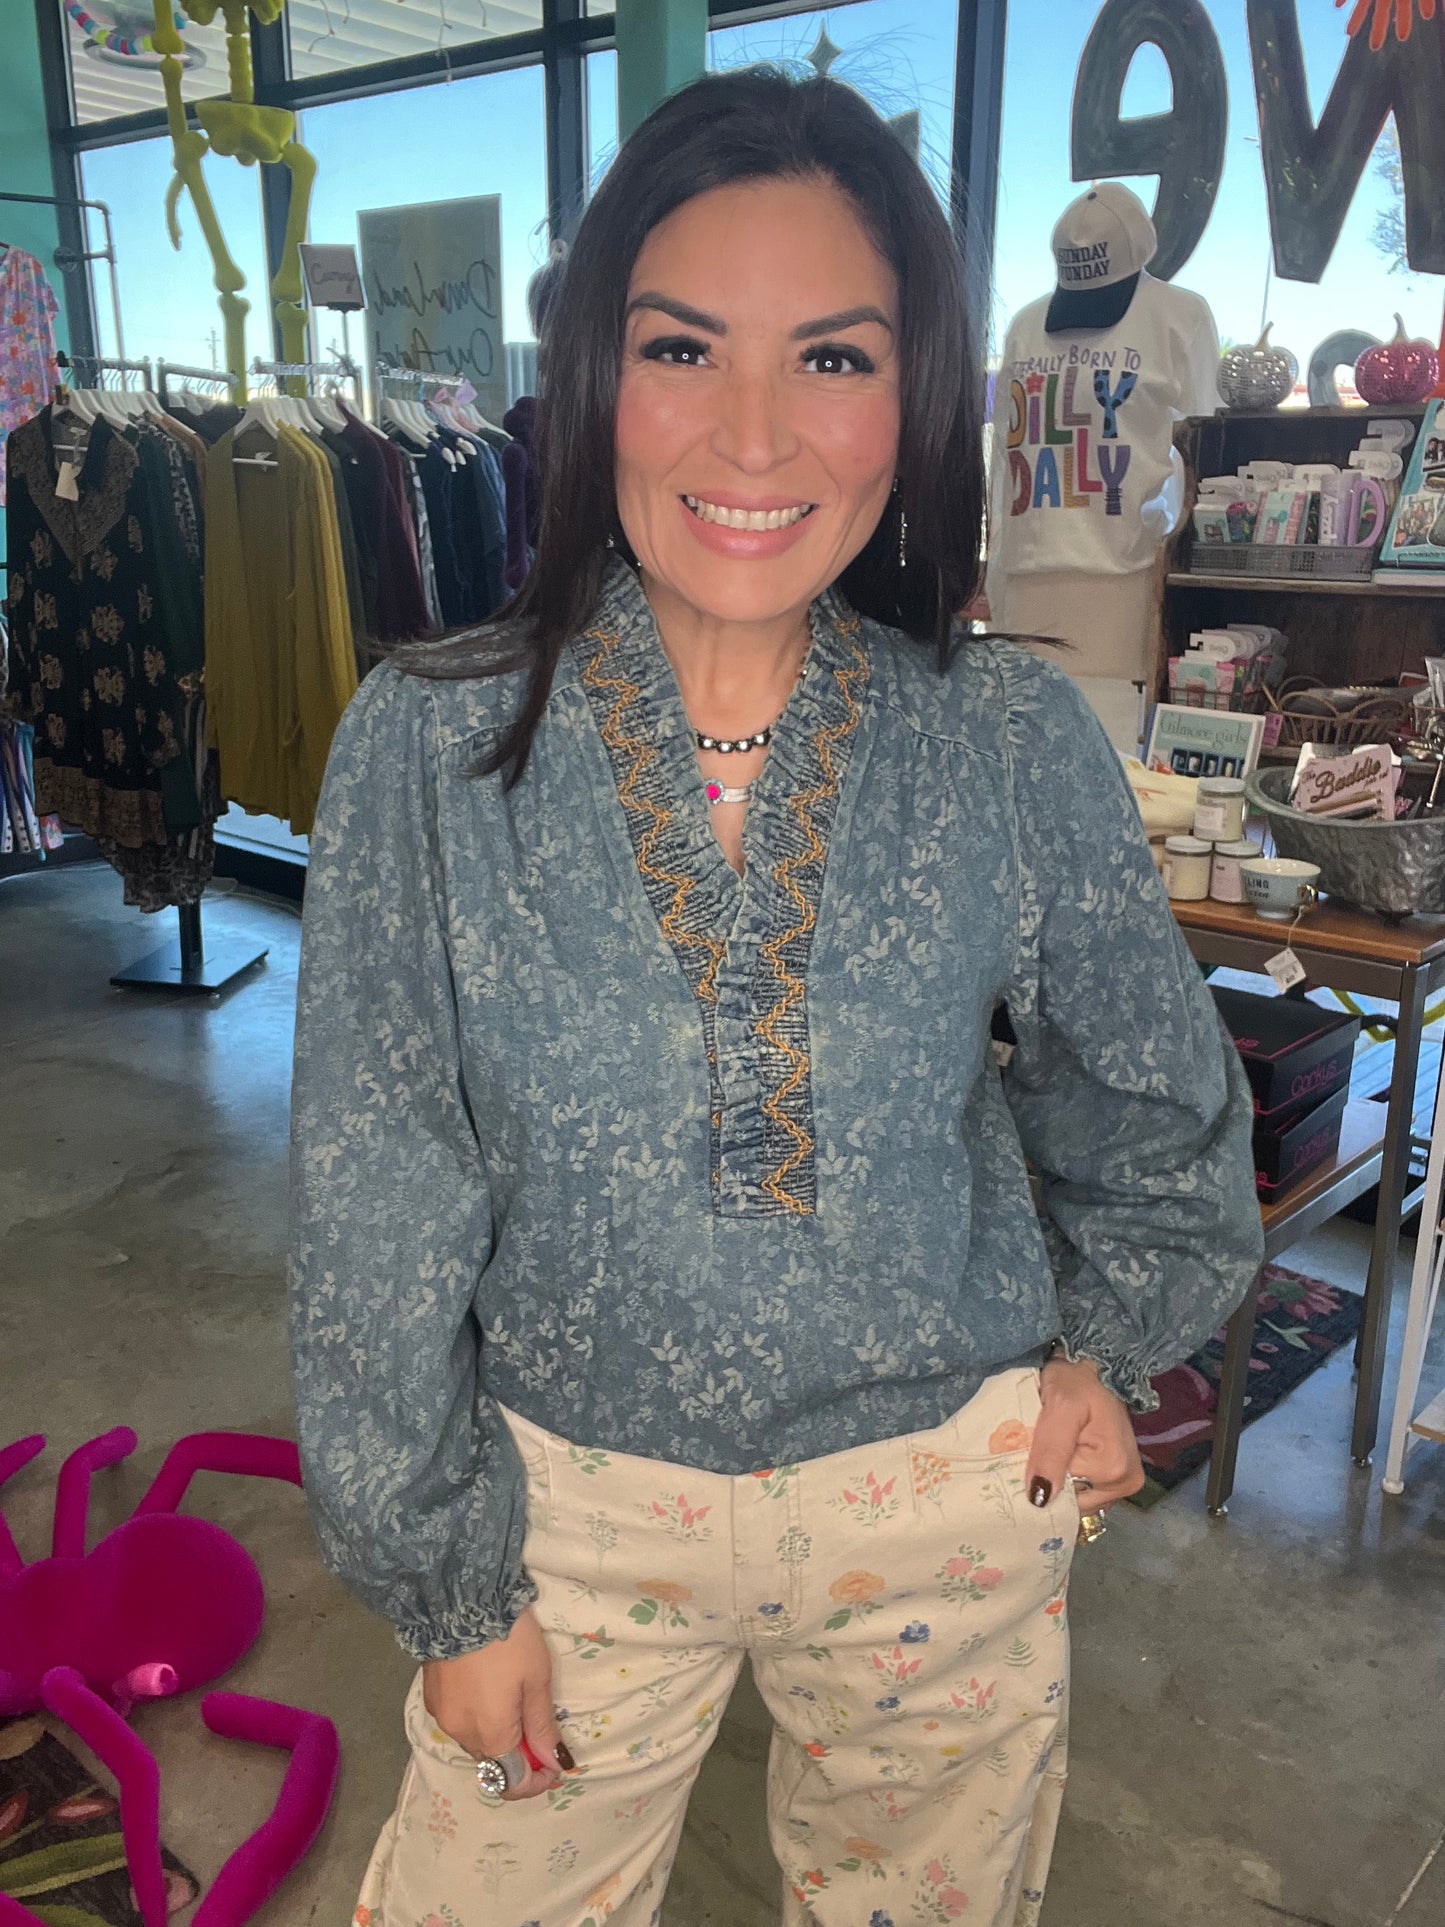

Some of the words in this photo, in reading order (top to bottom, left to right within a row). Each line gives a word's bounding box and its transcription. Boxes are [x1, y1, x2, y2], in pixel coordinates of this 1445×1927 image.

[1068, 343, 1118, 369] BORN
[1124, 346, 1142, 371] TO
[1007, 427, 1132, 517] DALLY
[1211, 722, 1248, 750] girls
